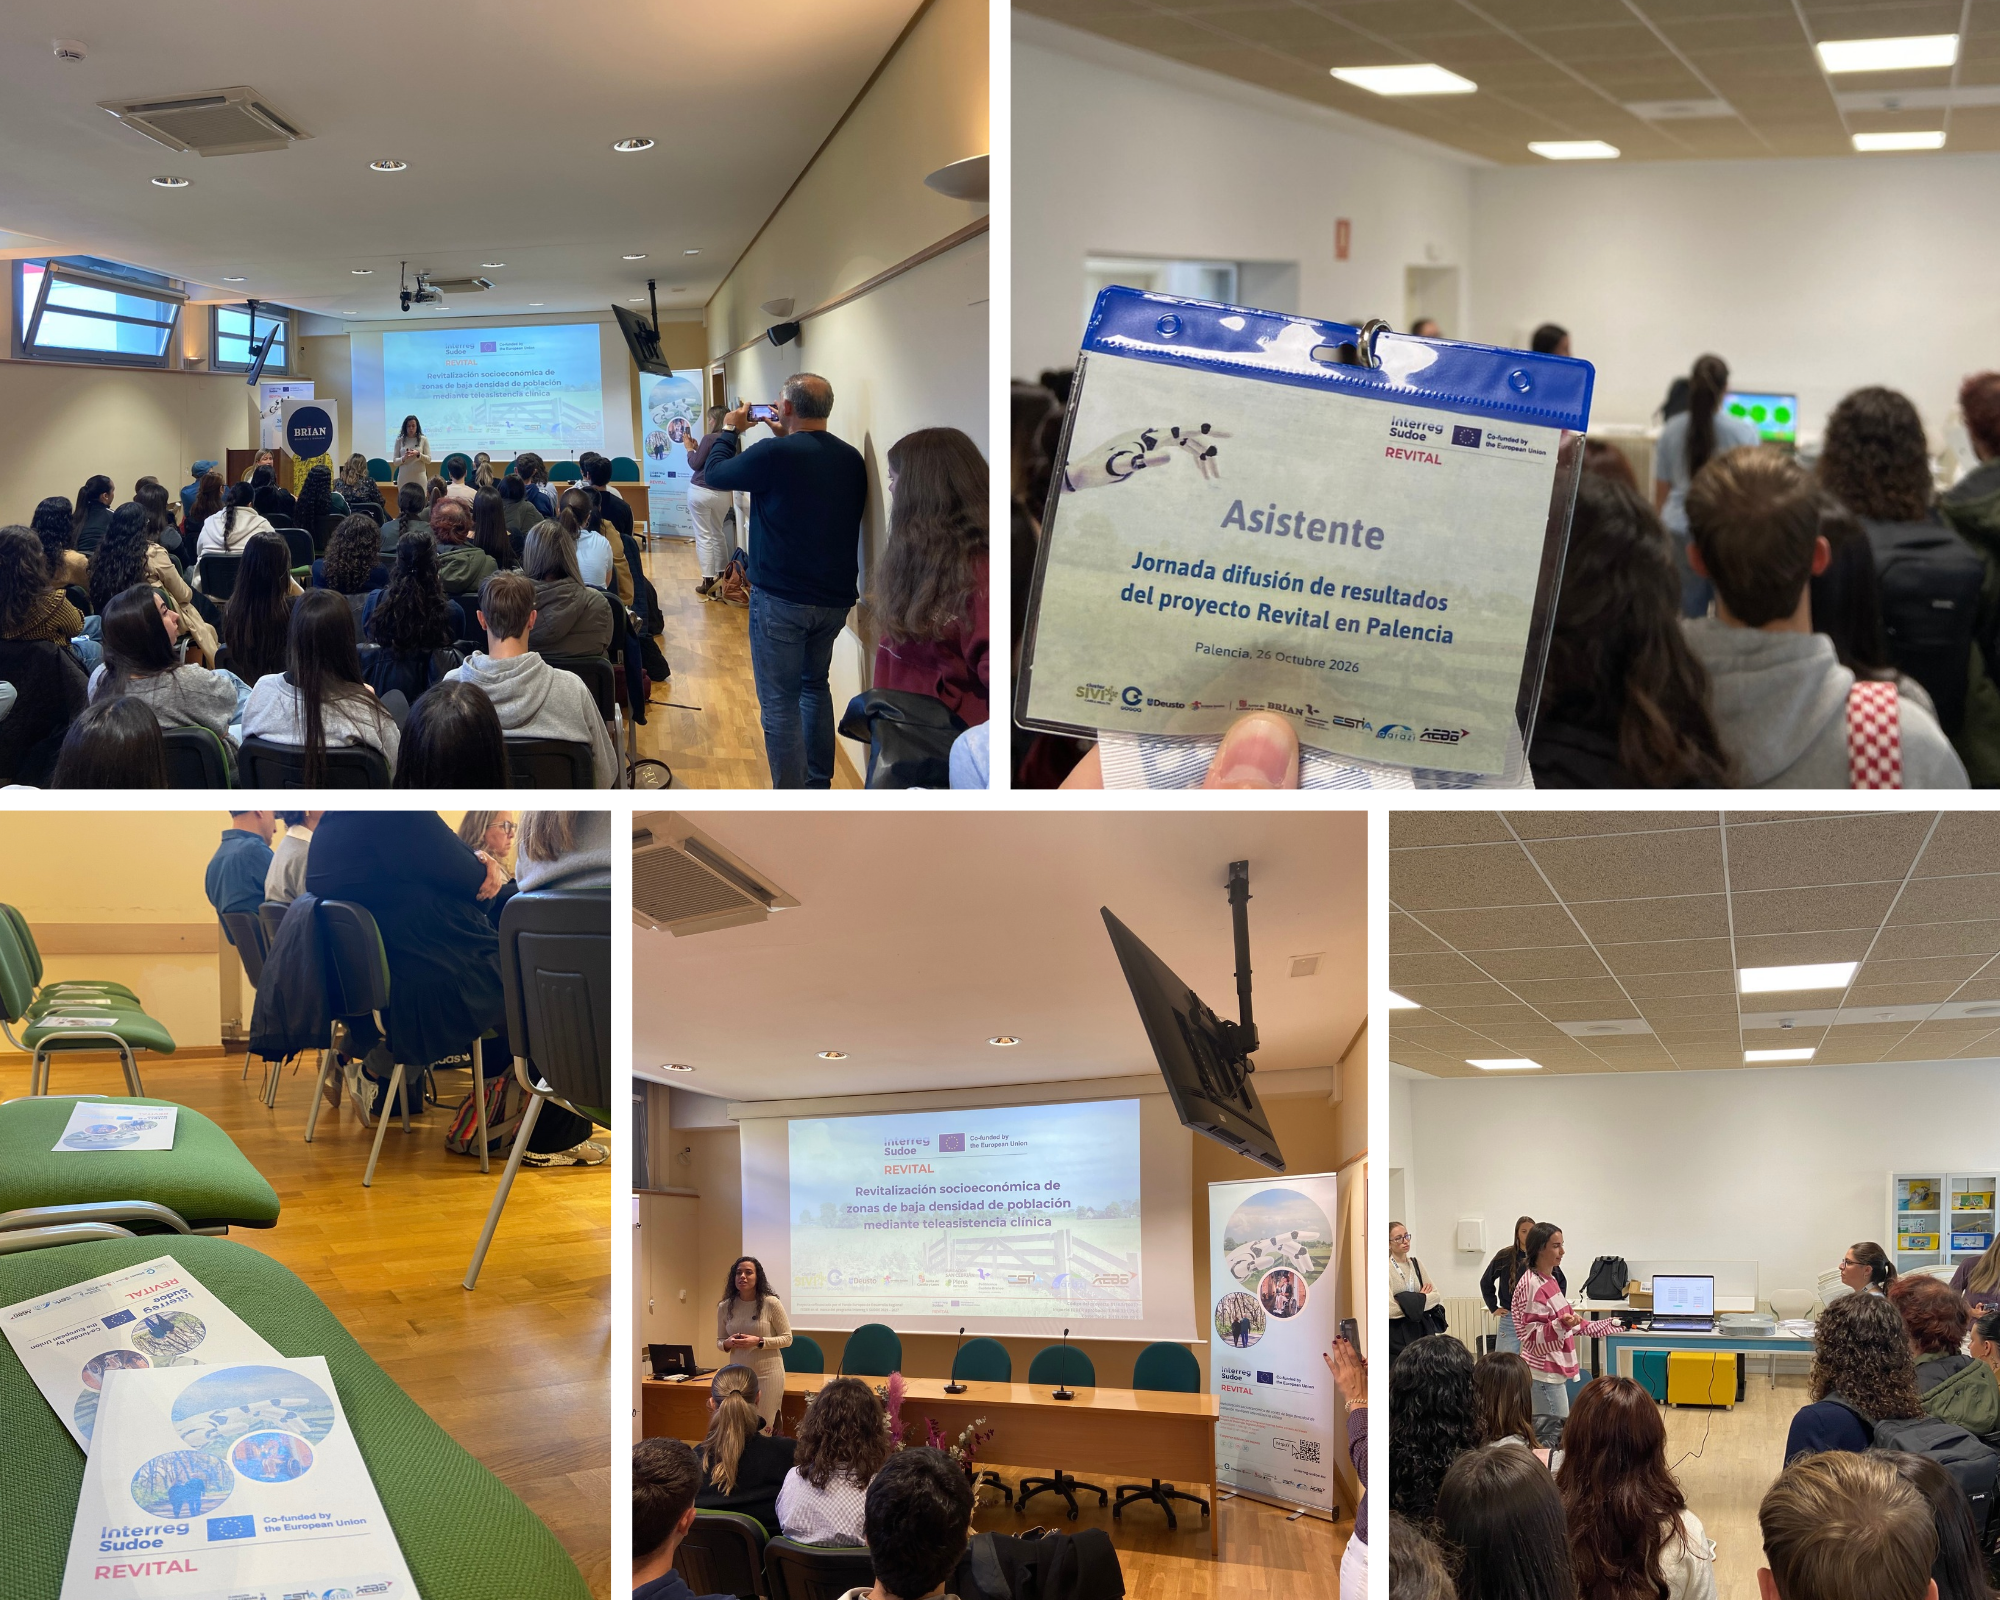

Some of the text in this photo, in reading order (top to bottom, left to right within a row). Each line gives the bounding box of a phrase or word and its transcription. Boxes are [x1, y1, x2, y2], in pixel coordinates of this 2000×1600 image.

[481, 370, 543, 378] socioeconómica
[457, 382, 473, 390] baja
[475, 381, 510, 389] densidad
[524, 379, 562, 388] población
[471, 391, 524, 399] teleasistencia
[1392, 416, 1443, 435] Interreg
[1390, 428, 1426, 441] Sudoe
[1487, 433, 1519, 445] Co-funded
[1385, 447, 1442, 465] REVITAL
[1497, 443, 1527, 454] European
[1528, 448, 1547, 456] Union
[1220, 500, 1385, 550] Asistente
[1132, 552, 1448, 611] Jornada difusión de resultados
[1121, 583, 1454, 644] del proyecto Revital en Palencia
[1195, 642, 1360, 673] Palencia, 26 Octubre 2026
[1076, 686, 1105, 701] SIVI
[1154, 699, 1185, 709] Deusto
[885, 1136, 930, 1147] Interreg
[1001, 1134, 1009, 1142] by
[885, 1147, 917, 1156] Sudoe
[981, 1141, 1009, 1150] European
[885, 1164, 935, 1175] REVITAL
[856, 1180, 1061, 1197] Revitalización socioeconómica de
[847, 1198, 1071, 1214] zonas de baja densidad de población
[864, 1216, 1052, 1230] mediante teleasistencia clínica
[125, 1278, 180, 1300] REVITAL
[153, 1288, 189, 1303] Sudoe
[143, 1294, 195, 1314] Interreg
[53, 1327, 86, 1342] European
[66, 1327, 101, 1343] Co-funded
[31, 1339, 53, 1350] Union
[1221, 1373, 1243, 1381] Sudoe
[1222, 1366, 1252, 1377] Interreg
[1221, 1385, 1254, 1395] REVITAL
[263, 1512, 332, 1524] Co-funded by
[265, 1517, 367, 1533] the European Union
[101, 1522, 190, 1540] Interreg
[99, 1537, 164, 1552] Sudoe
[94, 1559, 198, 1580] REVITAL
